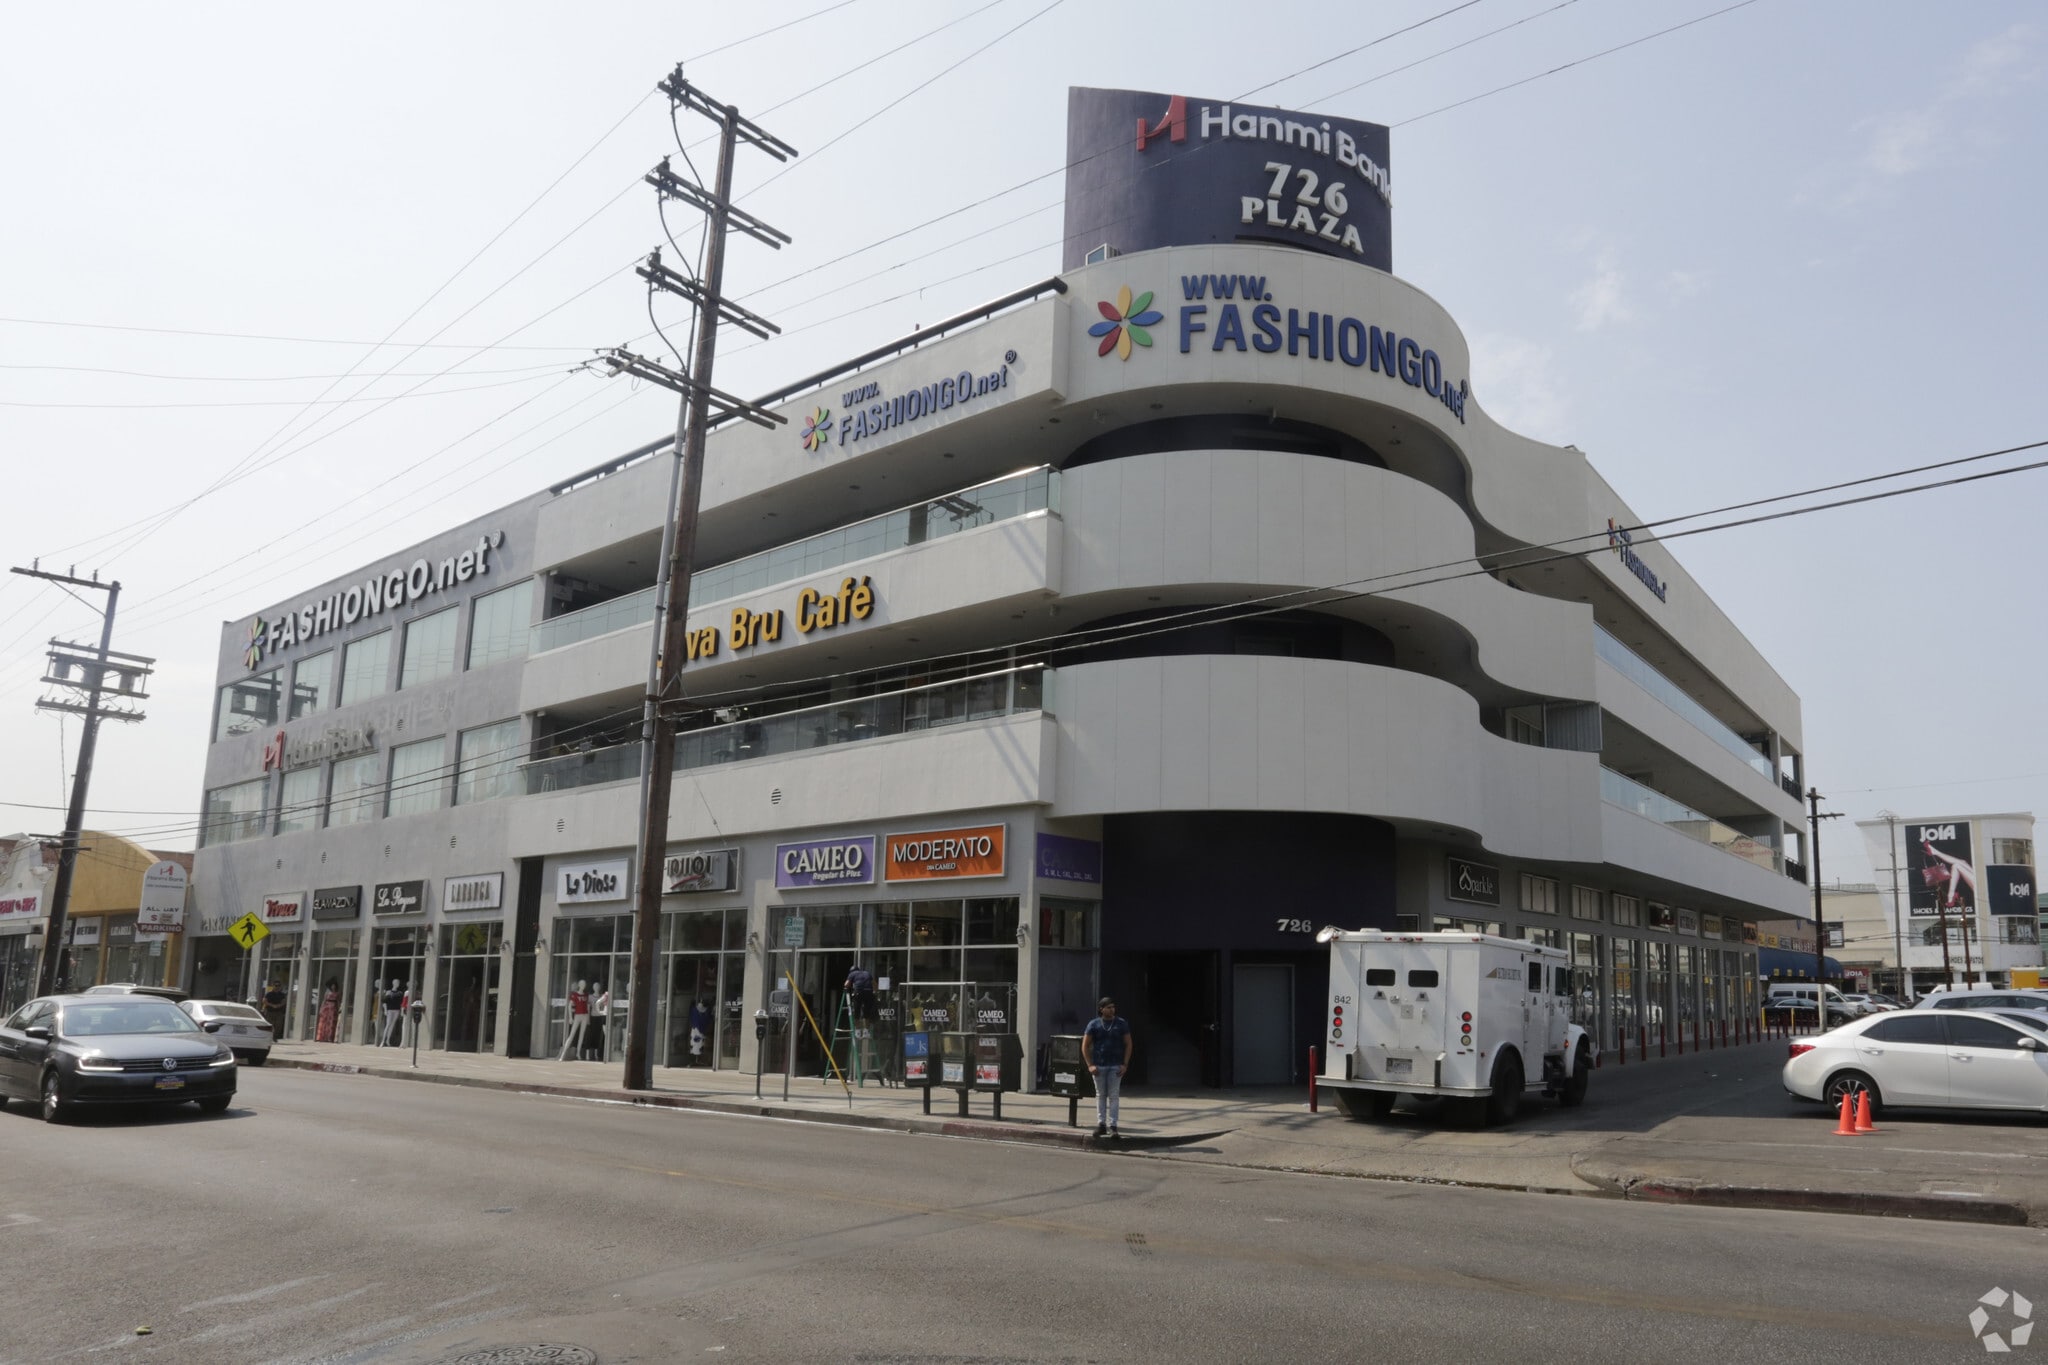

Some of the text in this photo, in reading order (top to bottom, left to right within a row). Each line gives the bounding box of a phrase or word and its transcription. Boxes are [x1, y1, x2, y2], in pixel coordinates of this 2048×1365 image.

[1200, 105, 1393, 208] Hanmi Bank
[1264, 160, 1349, 217] 726
[1240, 195, 1365, 254] PLAZA
[729, 607, 783, 652] Bru
[795, 575, 876, 634] Café
[783, 844, 863, 874] CAMEO
[893, 835, 992, 862] MODERATO
[812, 871, 839, 881] Regular
[935, 862, 956, 871] CAMEO
[566, 869, 618, 896] La Diosa
[1277, 918, 1312, 933] 726
[923, 1009, 947, 1017] CAMEO
[1333, 995, 1351, 1004] 842
[978, 1010, 1004, 1019] CAMEO
